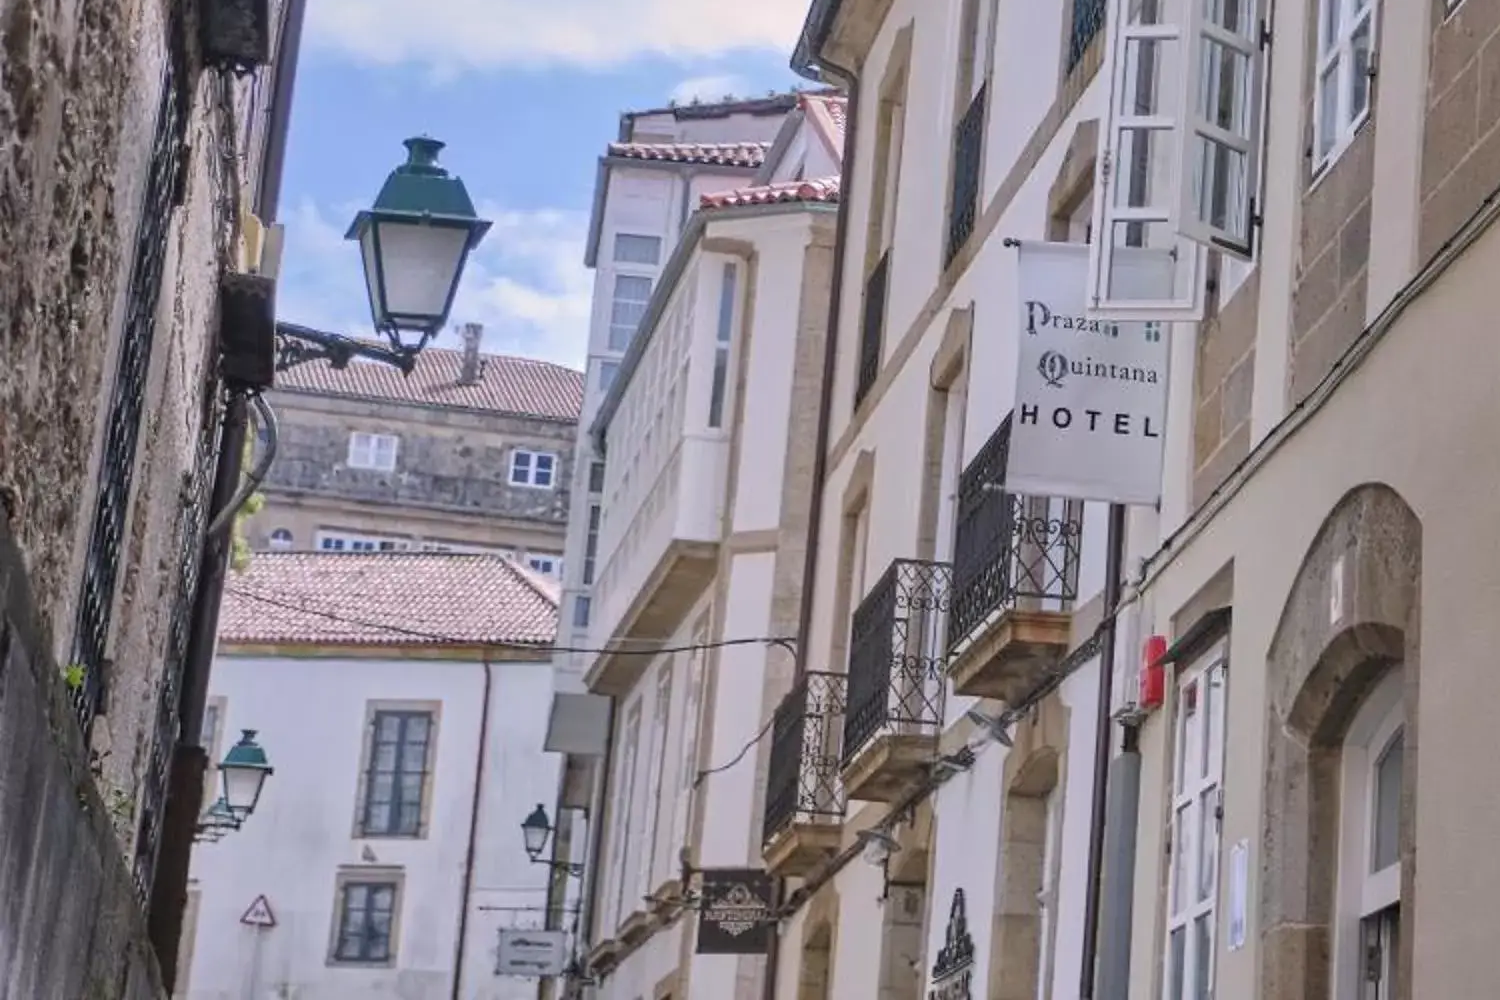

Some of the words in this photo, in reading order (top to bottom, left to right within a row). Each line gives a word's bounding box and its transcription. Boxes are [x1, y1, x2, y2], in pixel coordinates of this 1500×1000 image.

[1024, 300, 1101, 335] Praza
[1037, 350, 1158, 388] Quintana
[1020, 403, 1159, 437] HOTEL
